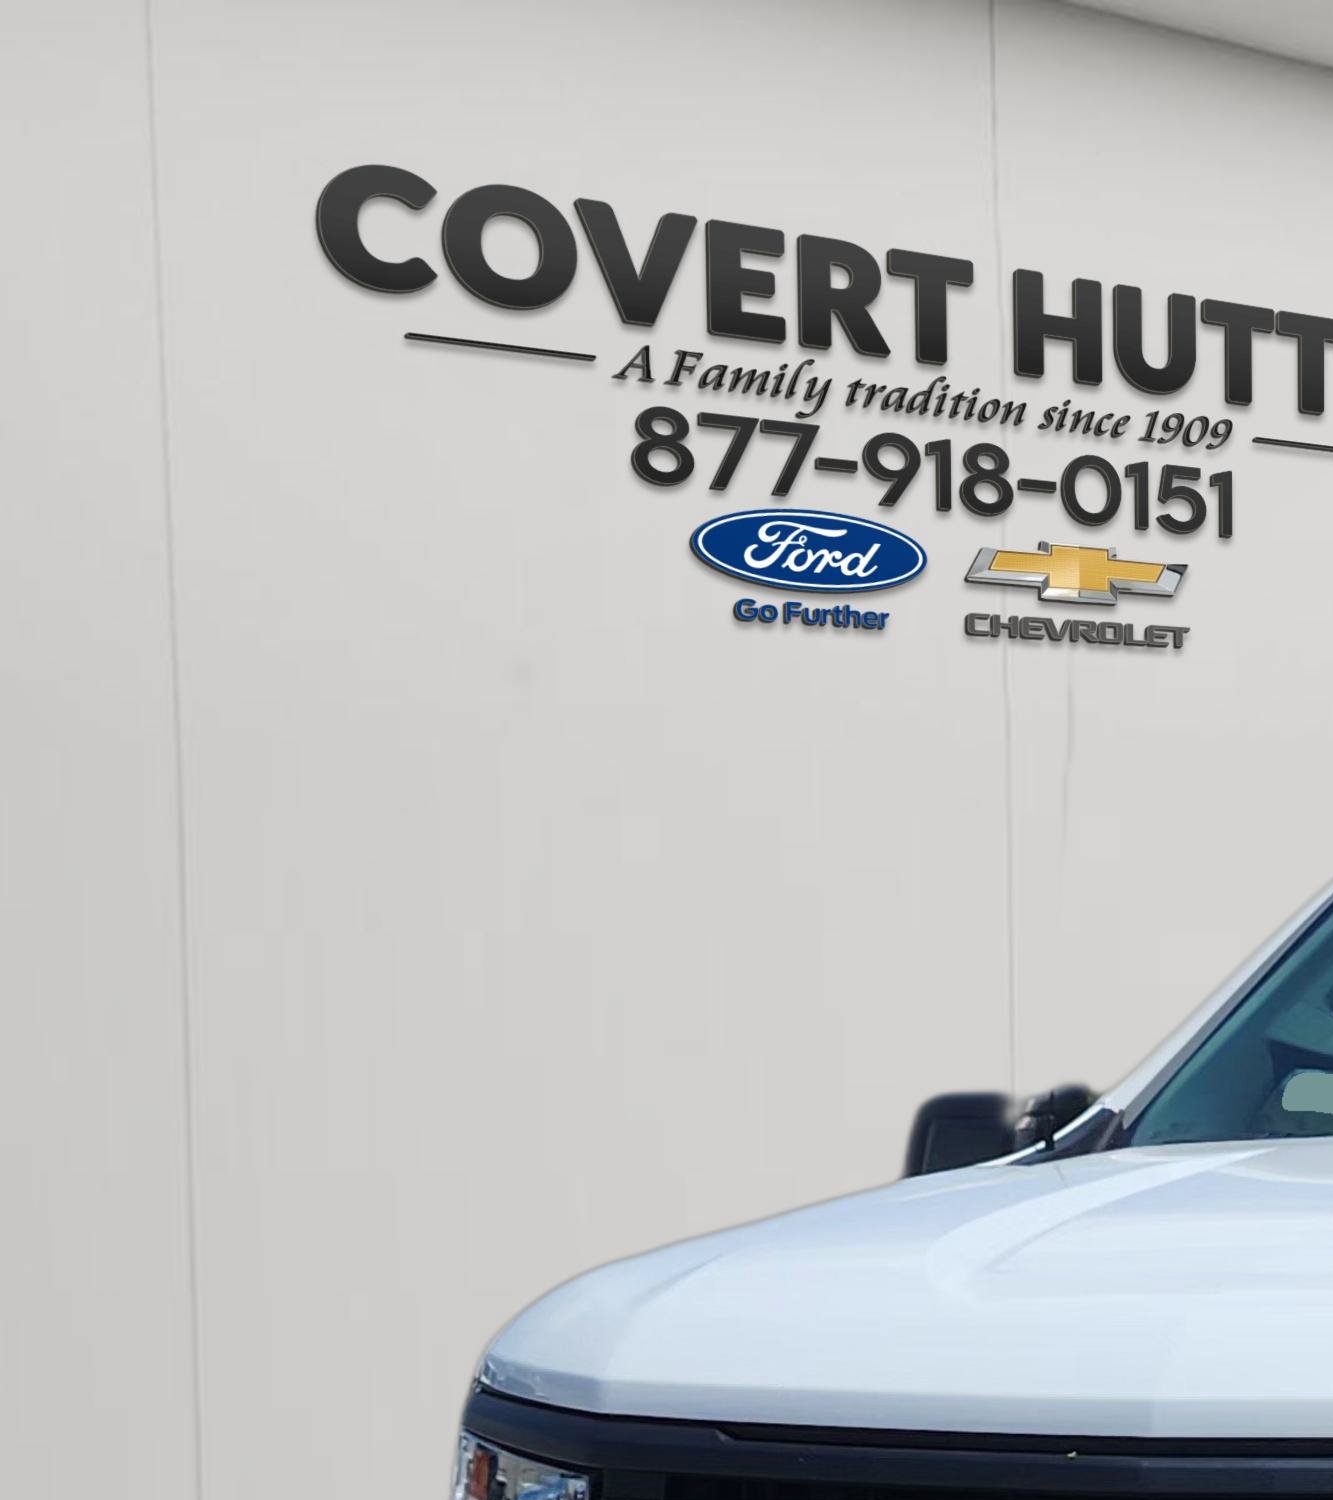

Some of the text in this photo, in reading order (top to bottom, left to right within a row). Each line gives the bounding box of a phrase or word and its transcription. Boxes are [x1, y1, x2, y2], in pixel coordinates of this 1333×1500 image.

[315, 164, 974, 366] COVERT
[612, 345, 1234, 450] A Family tradition since 1909
[630, 406, 1234, 538] 877-918-0151
[743, 520, 880, 578] Ford
[733, 599, 890, 630] Go Further
[964, 612, 1191, 649] CHEVROLET
